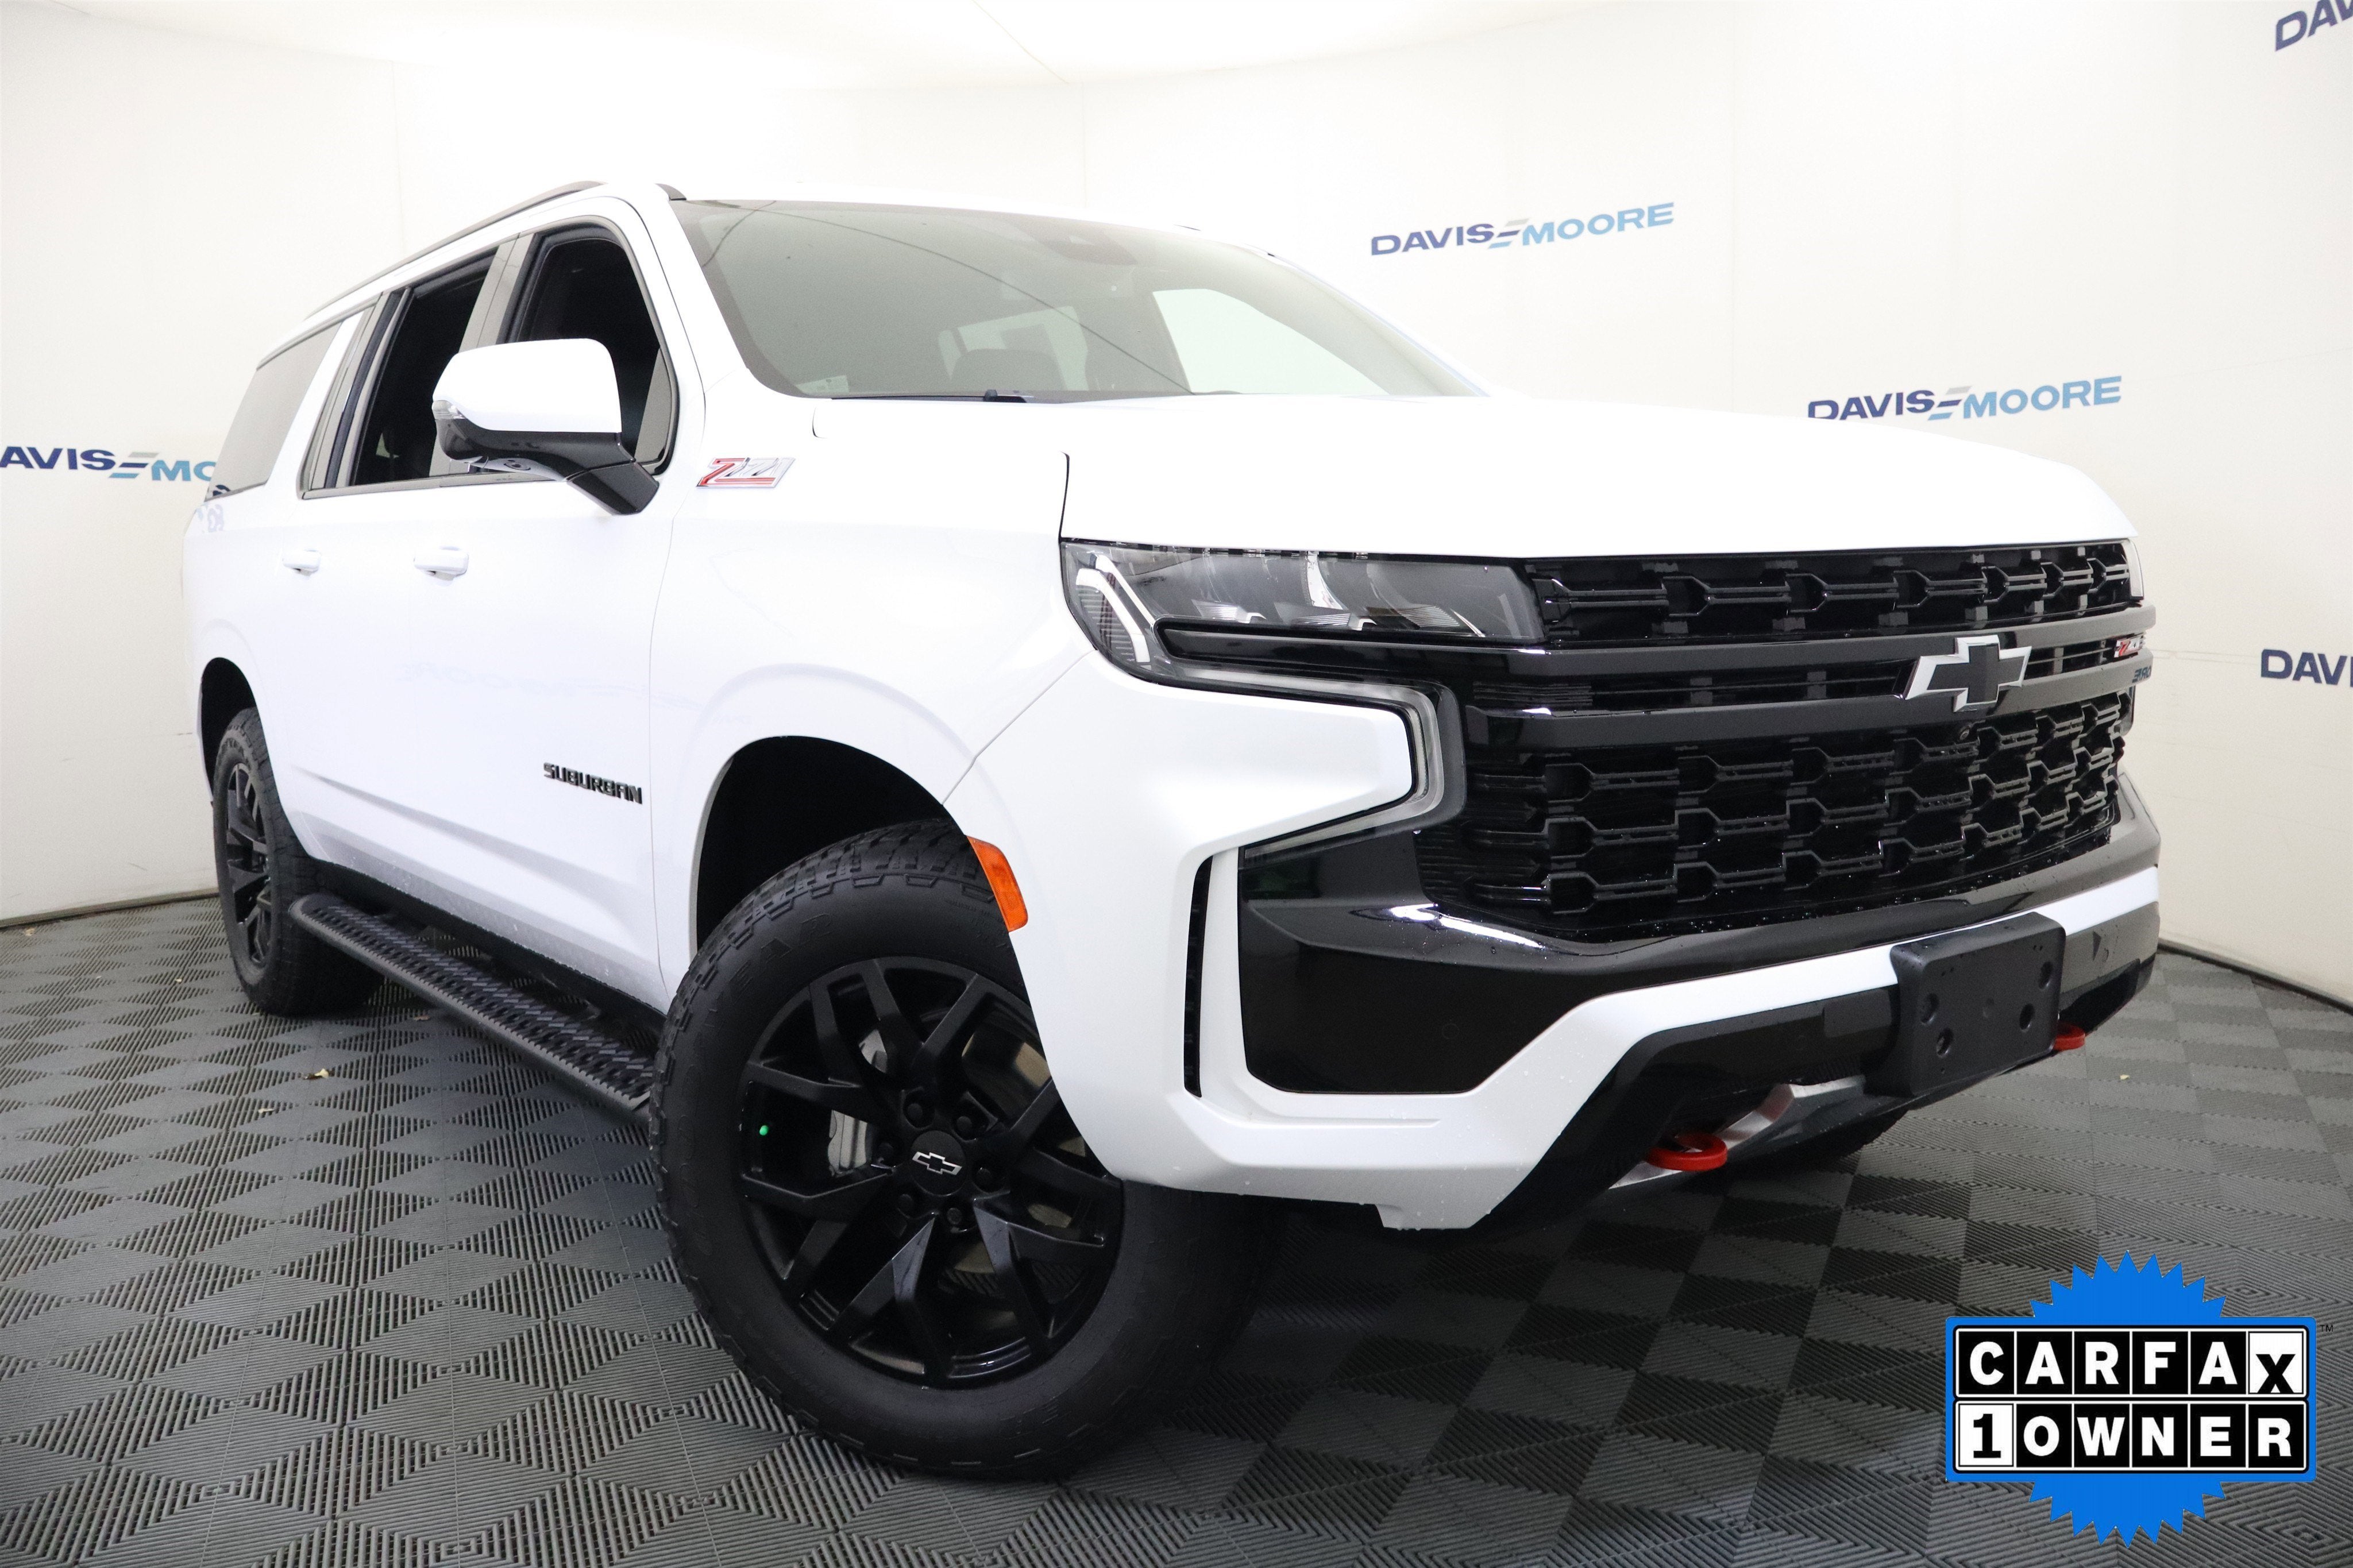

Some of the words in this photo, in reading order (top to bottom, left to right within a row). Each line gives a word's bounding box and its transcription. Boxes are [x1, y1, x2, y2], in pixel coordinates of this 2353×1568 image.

[1371, 223, 1494, 256] DAVIS
[1522, 203, 1674, 246] MOORE
[1808, 389, 1935, 420] DAVIS
[1964, 376, 2121, 419] MOORE
[543, 762, 643, 805] SUBURBAN
